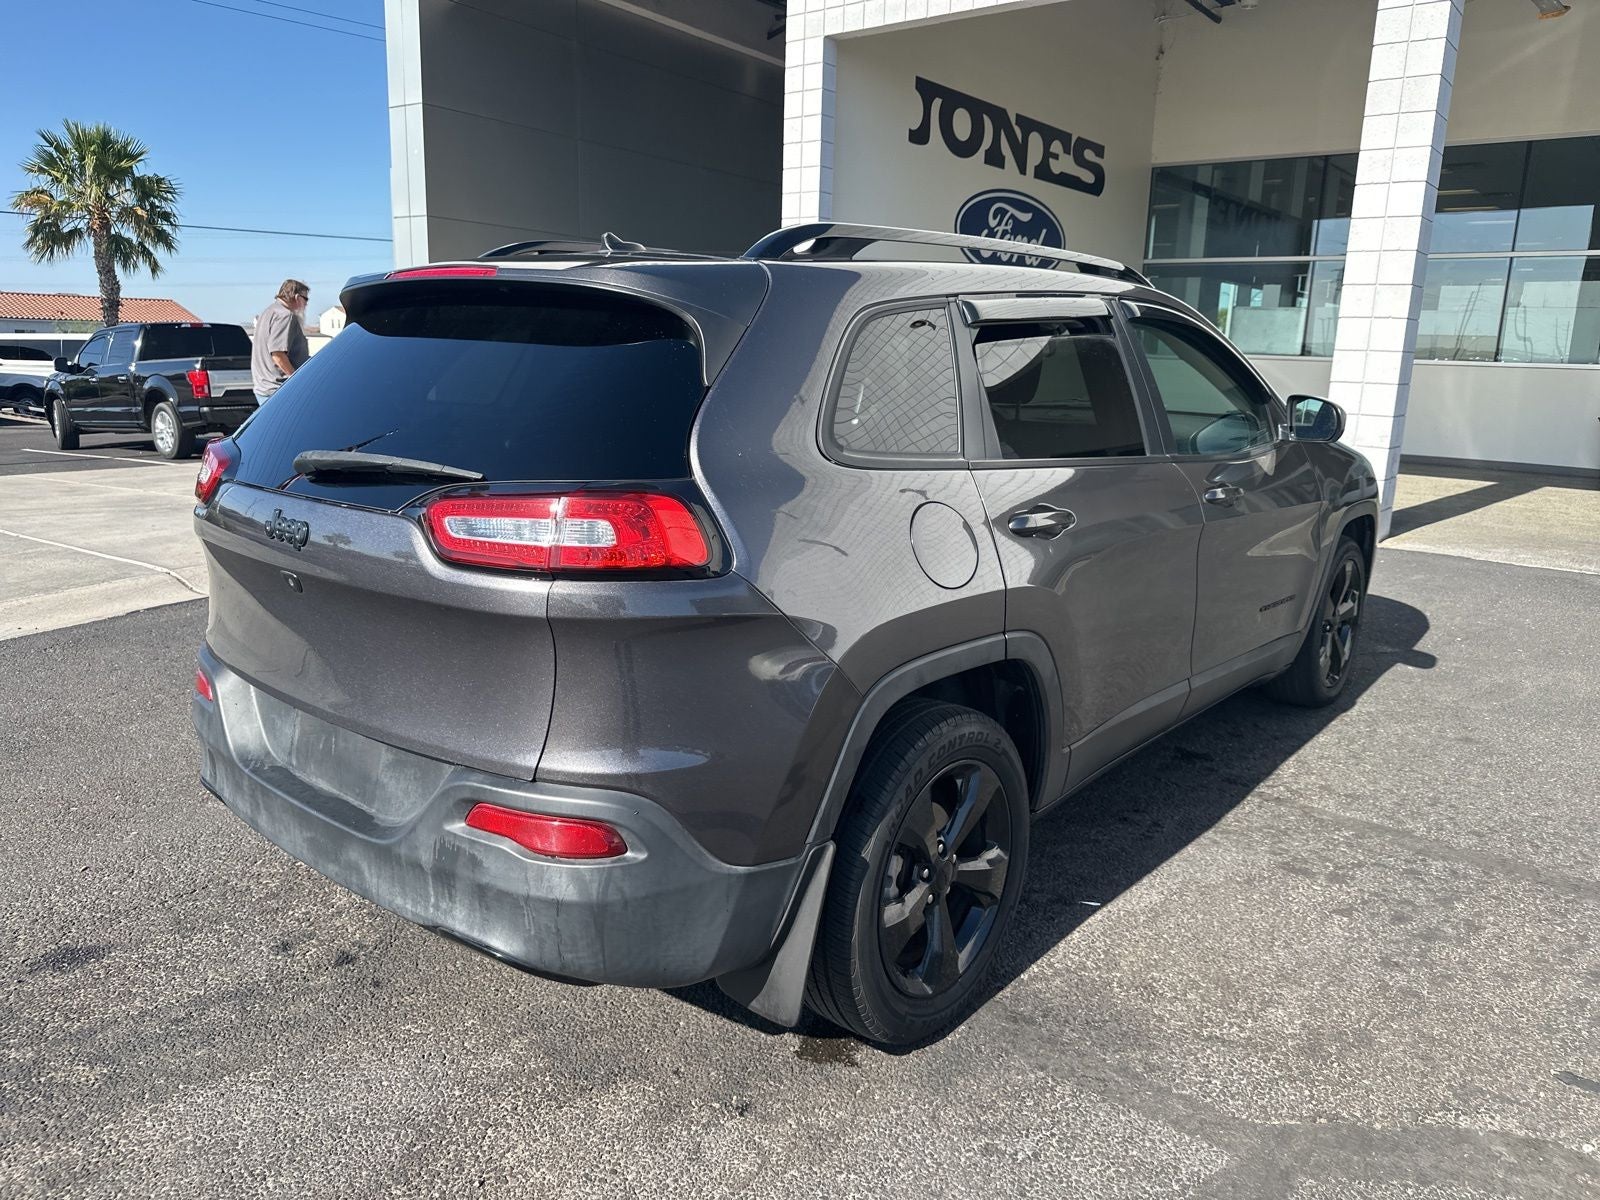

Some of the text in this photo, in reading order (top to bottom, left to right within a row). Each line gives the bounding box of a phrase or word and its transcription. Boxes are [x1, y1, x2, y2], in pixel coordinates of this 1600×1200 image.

[908, 75, 1105, 197] JONES
[980, 202, 1047, 266] Ford
[265, 508, 309, 551] Jeep
[927, 731, 990, 768] CONTROL
